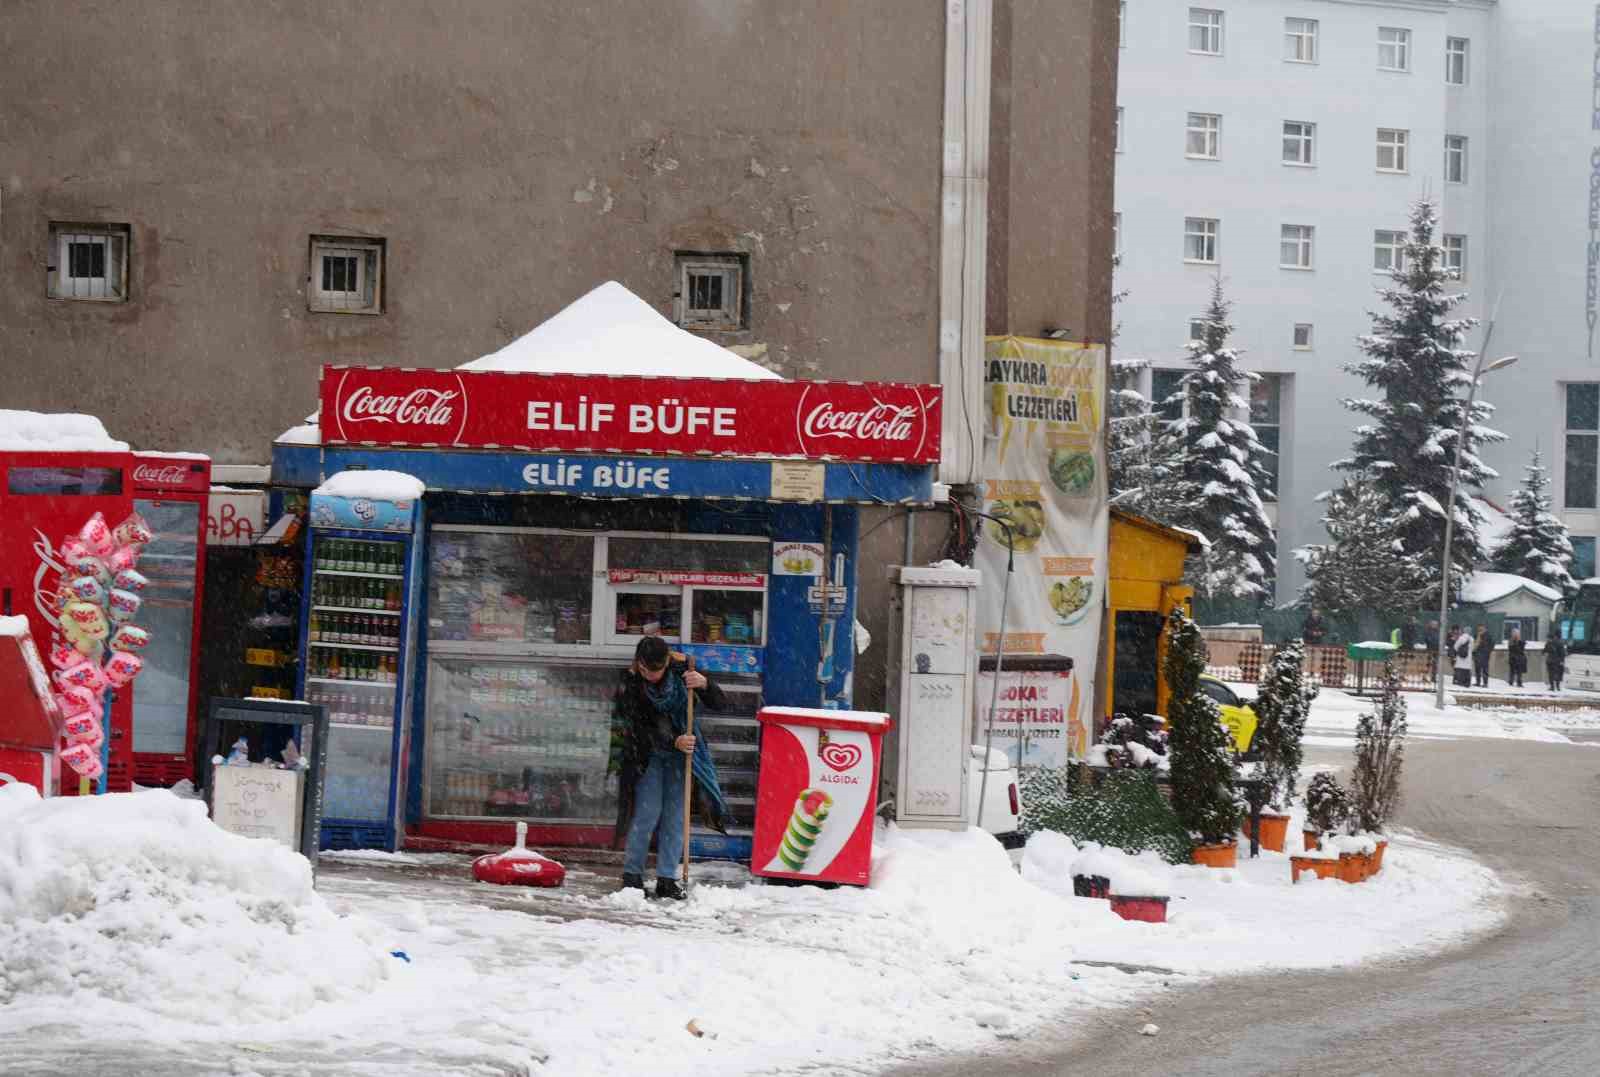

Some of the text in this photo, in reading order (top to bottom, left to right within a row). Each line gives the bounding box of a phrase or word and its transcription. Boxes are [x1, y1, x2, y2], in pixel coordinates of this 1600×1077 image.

[344, 386, 459, 426] Coca-Cola
[527, 395, 737, 436] ELİF BÜFE
[804, 402, 917, 440] Coca-Cola
[1007, 394, 1078, 422] LEZZETLERİ
[135, 464, 187, 483] Coca-Cola
[522, 458, 670, 489] ELİF BÜFE
[820, 774, 858, 785] ALGIDA
